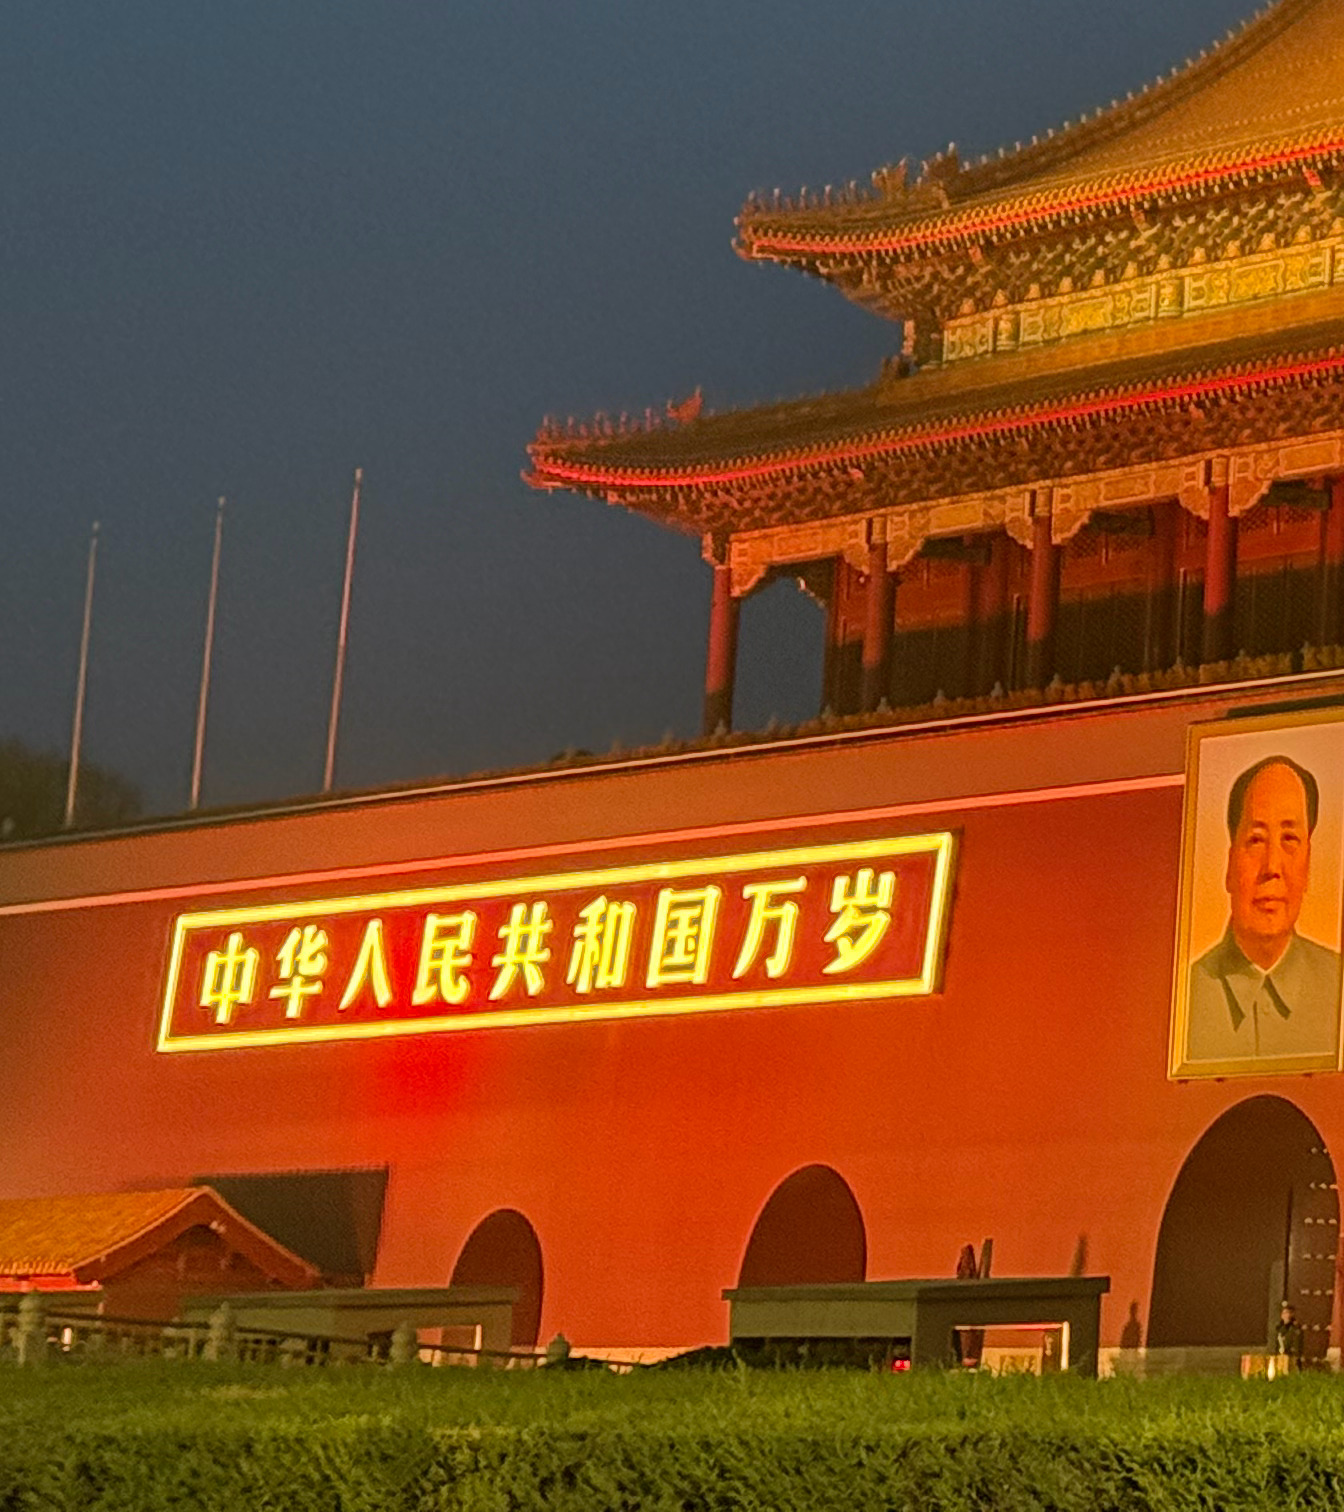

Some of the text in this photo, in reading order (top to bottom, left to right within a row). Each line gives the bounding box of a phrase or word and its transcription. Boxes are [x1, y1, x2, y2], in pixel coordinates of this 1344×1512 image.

[198, 867, 898, 1024] 中华人民共和国万岁
